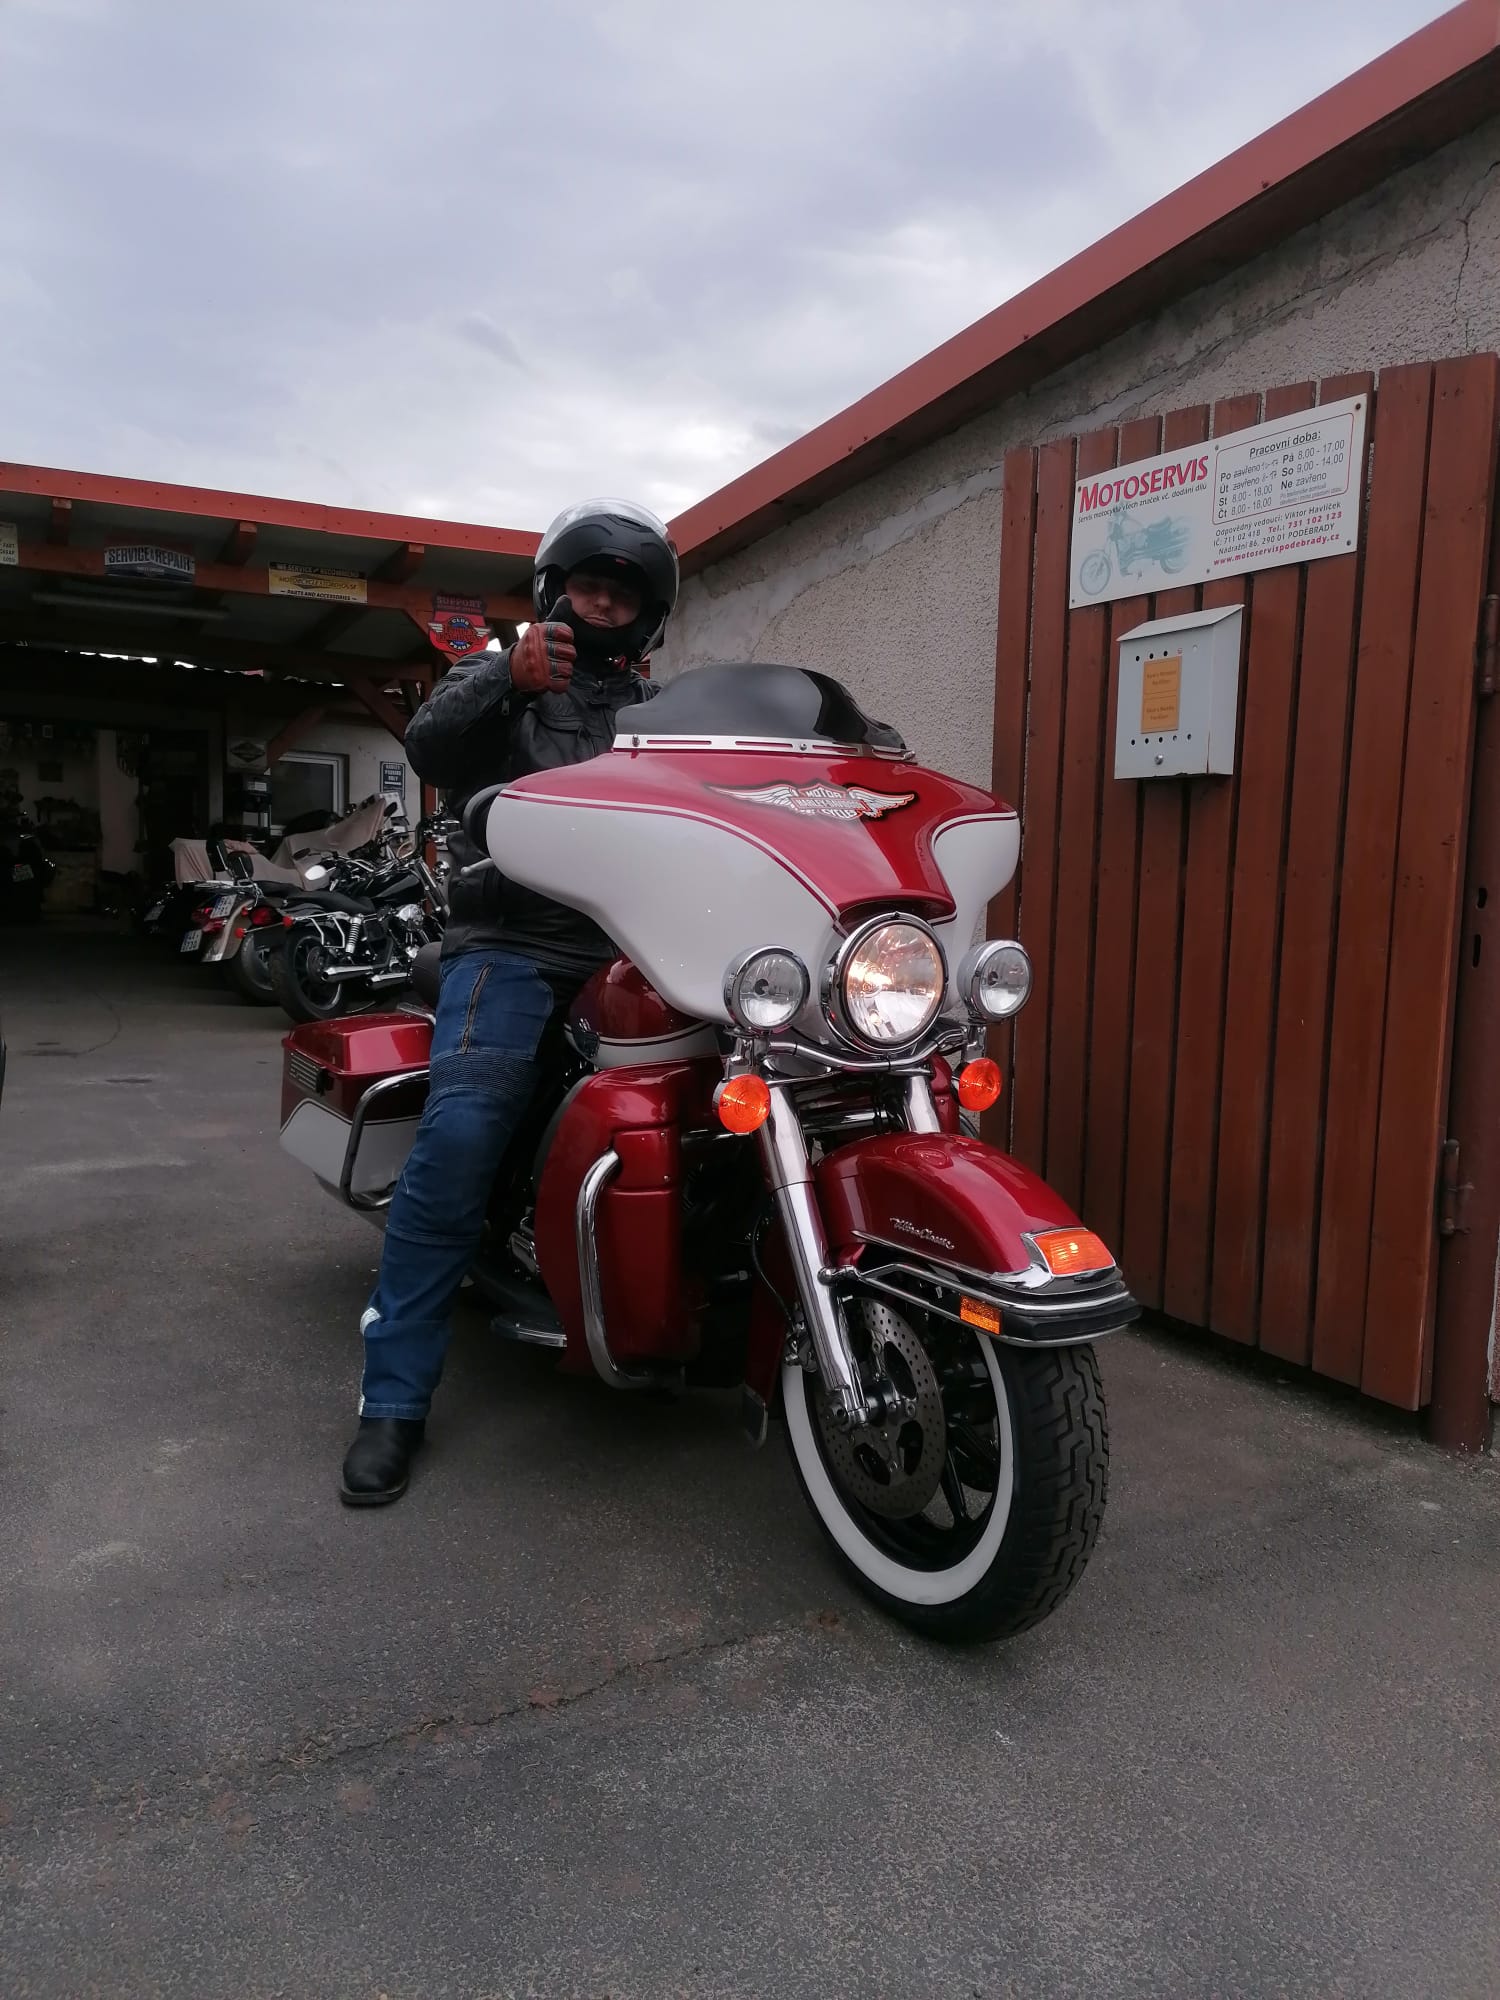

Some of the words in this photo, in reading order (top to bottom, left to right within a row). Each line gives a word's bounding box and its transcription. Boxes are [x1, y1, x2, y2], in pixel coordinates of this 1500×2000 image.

[1249, 436, 1291, 458] Pracovní
[1292, 431, 1321, 445] doba:
[1282, 453, 1294, 464] Pá
[1220, 472, 1232, 482] Po
[1281, 467, 1294, 477] So
[1079, 455, 1209, 513] MOTOSERVIS
[1219, 481, 1229, 494] Út
[1280, 480, 1293, 490] Ne
[1295, 472, 1327, 487] zavřeno
[1218, 496, 1228, 507] St
[1217, 506, 1227, 519] Čt
[1284, 509, 1307, 520] Viktor
[1308, 501, 1341, 515] Havlíček
[1224, 535, 1235, 544] 711
[1237, 533, 1246, 542] 02
[1288, 519, 1303, 529] 731
[1306, 515, 1322, 525] 102
[1326, 511, 1342, 520] 123
[1261, 536, 1275, 545] 290
[1277, 533, 1285, 541] 01
[1213, 533, 1340, 566] www.motoservispodebrady.cz
[108, 545, 150, 564] SERVICE
[154, 548, 191, 572] REPAIR
[287, 589, 304, 597] PARTS
[316, 592, 351, 601] ACCESSORIES
[436, 595, 481, 608] SUPPORT
[451, 618, 469, 626] CLUB
[805, 787, 842, 799] MOTOR
